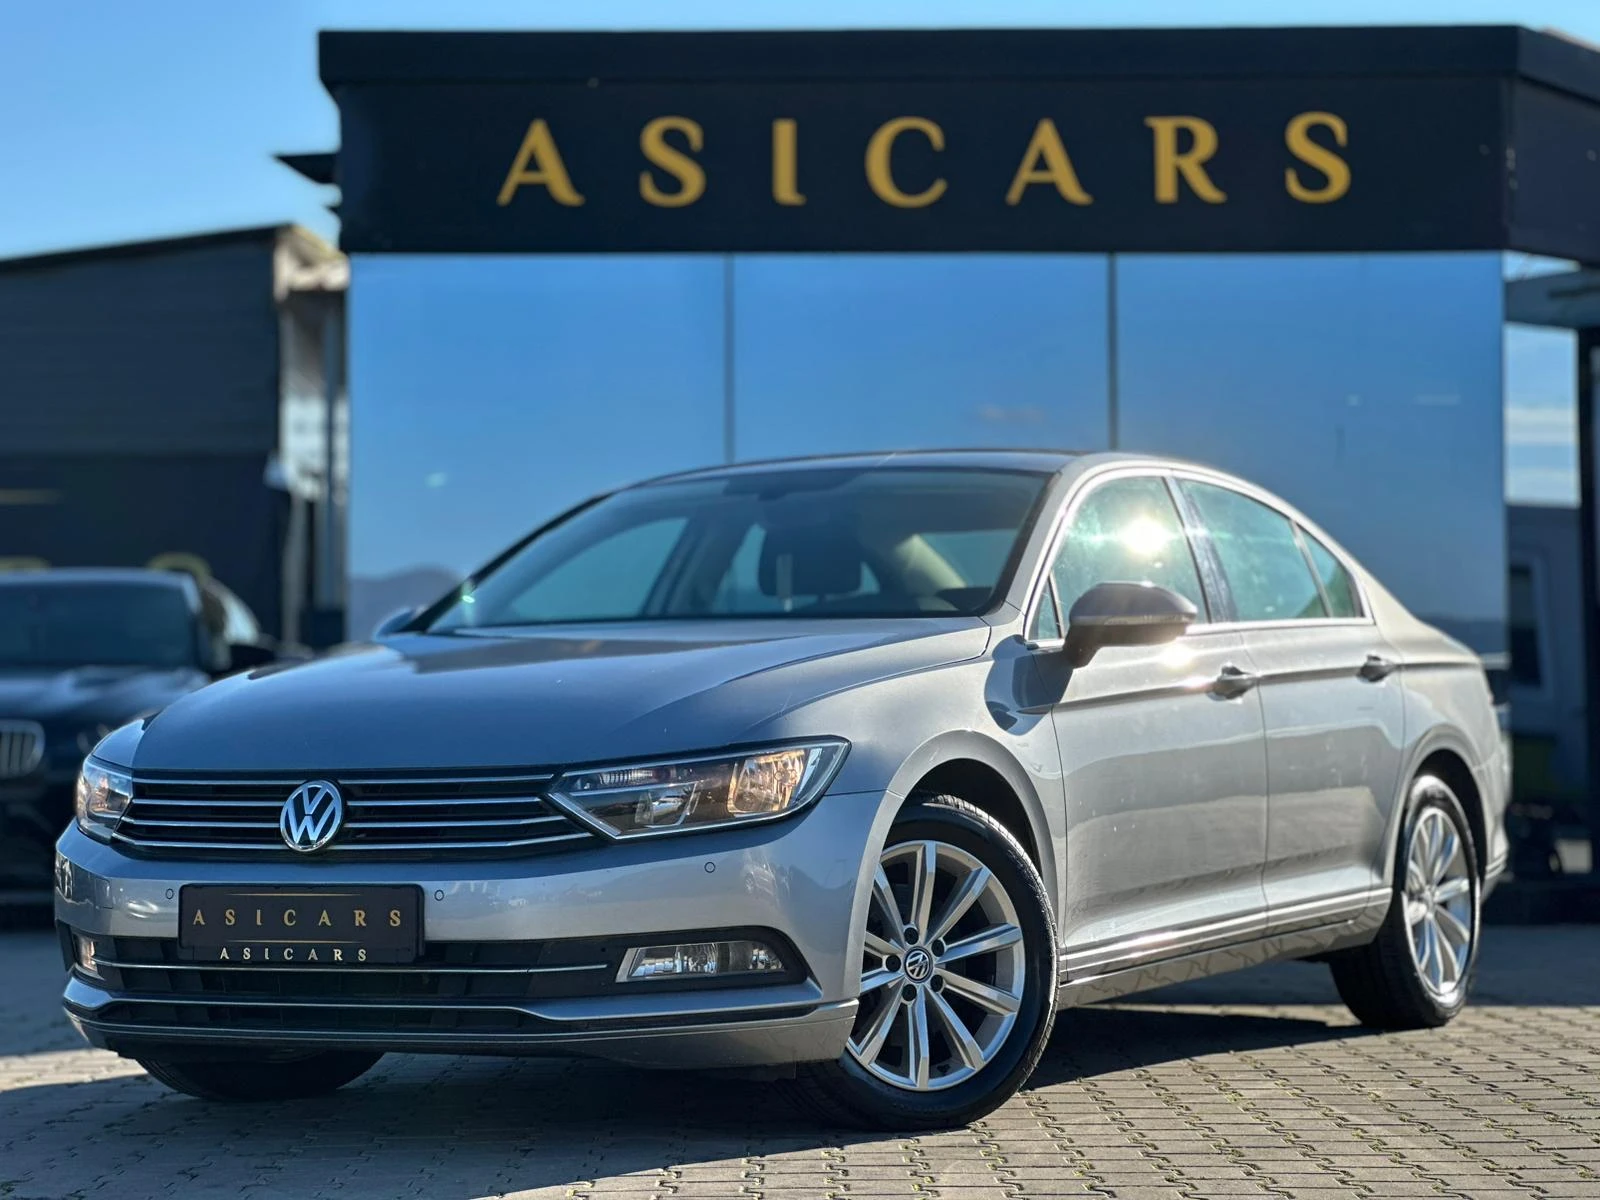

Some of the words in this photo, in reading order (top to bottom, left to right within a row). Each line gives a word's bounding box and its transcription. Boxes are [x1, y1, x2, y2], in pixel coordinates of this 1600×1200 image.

[497, 111, 1352, 207] ASICARS
[280, 780, 342, 852] VW
[193, 909, 401, 927] ASICARS
[219, 947, 367, 961] ASICARS
